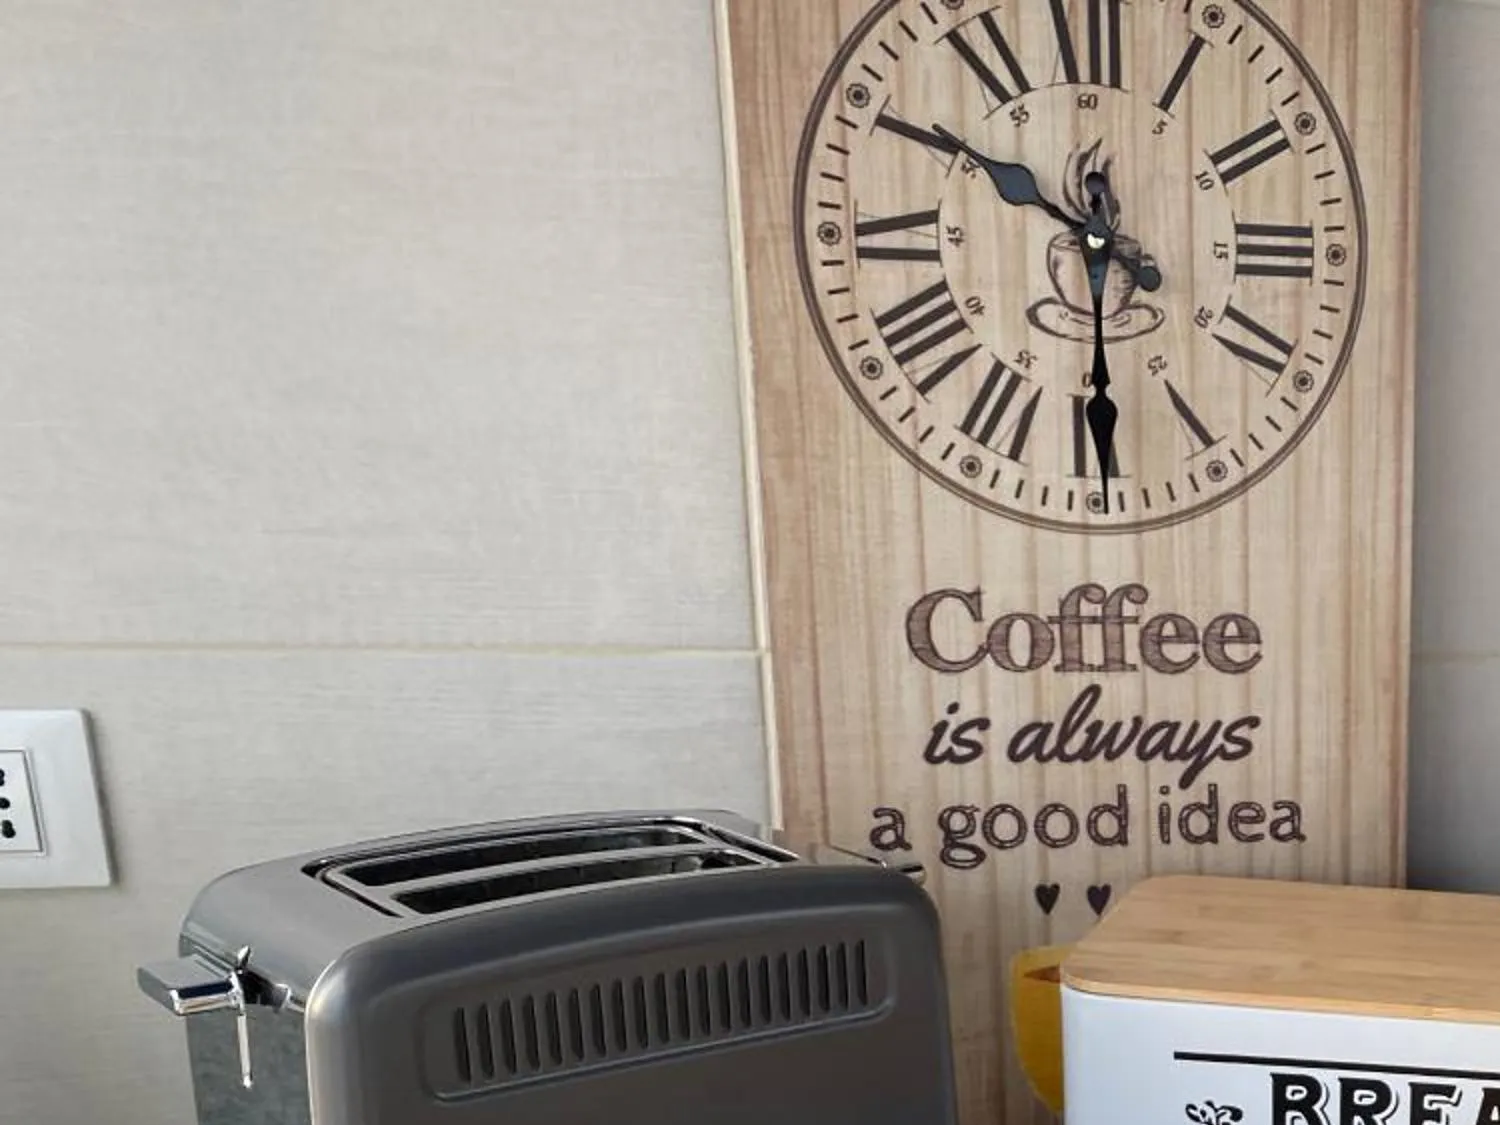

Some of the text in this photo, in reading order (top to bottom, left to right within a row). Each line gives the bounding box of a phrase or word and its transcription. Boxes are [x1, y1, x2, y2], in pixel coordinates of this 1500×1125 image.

[1076, 92, 1099, 111] 60
[1009, 103, 1030, 128] 55
[1151, 119, 1169, 136] 5
[1195, 170, 1215, 191] 10
[945, 224, 965, 247] 45
[1213, 241, 1229, 260] 15
[962, 295, 985, 317] 40
[1193, 306, 1214, 329] 20
[1013, 349, 1038, 369] 35
[1147, 355, 1168, 377] 25
[905, 583, 1264, 676] Coffee
[923, 684, 1262, 790] is always
[869, 783, 1307, 870] a good idea
